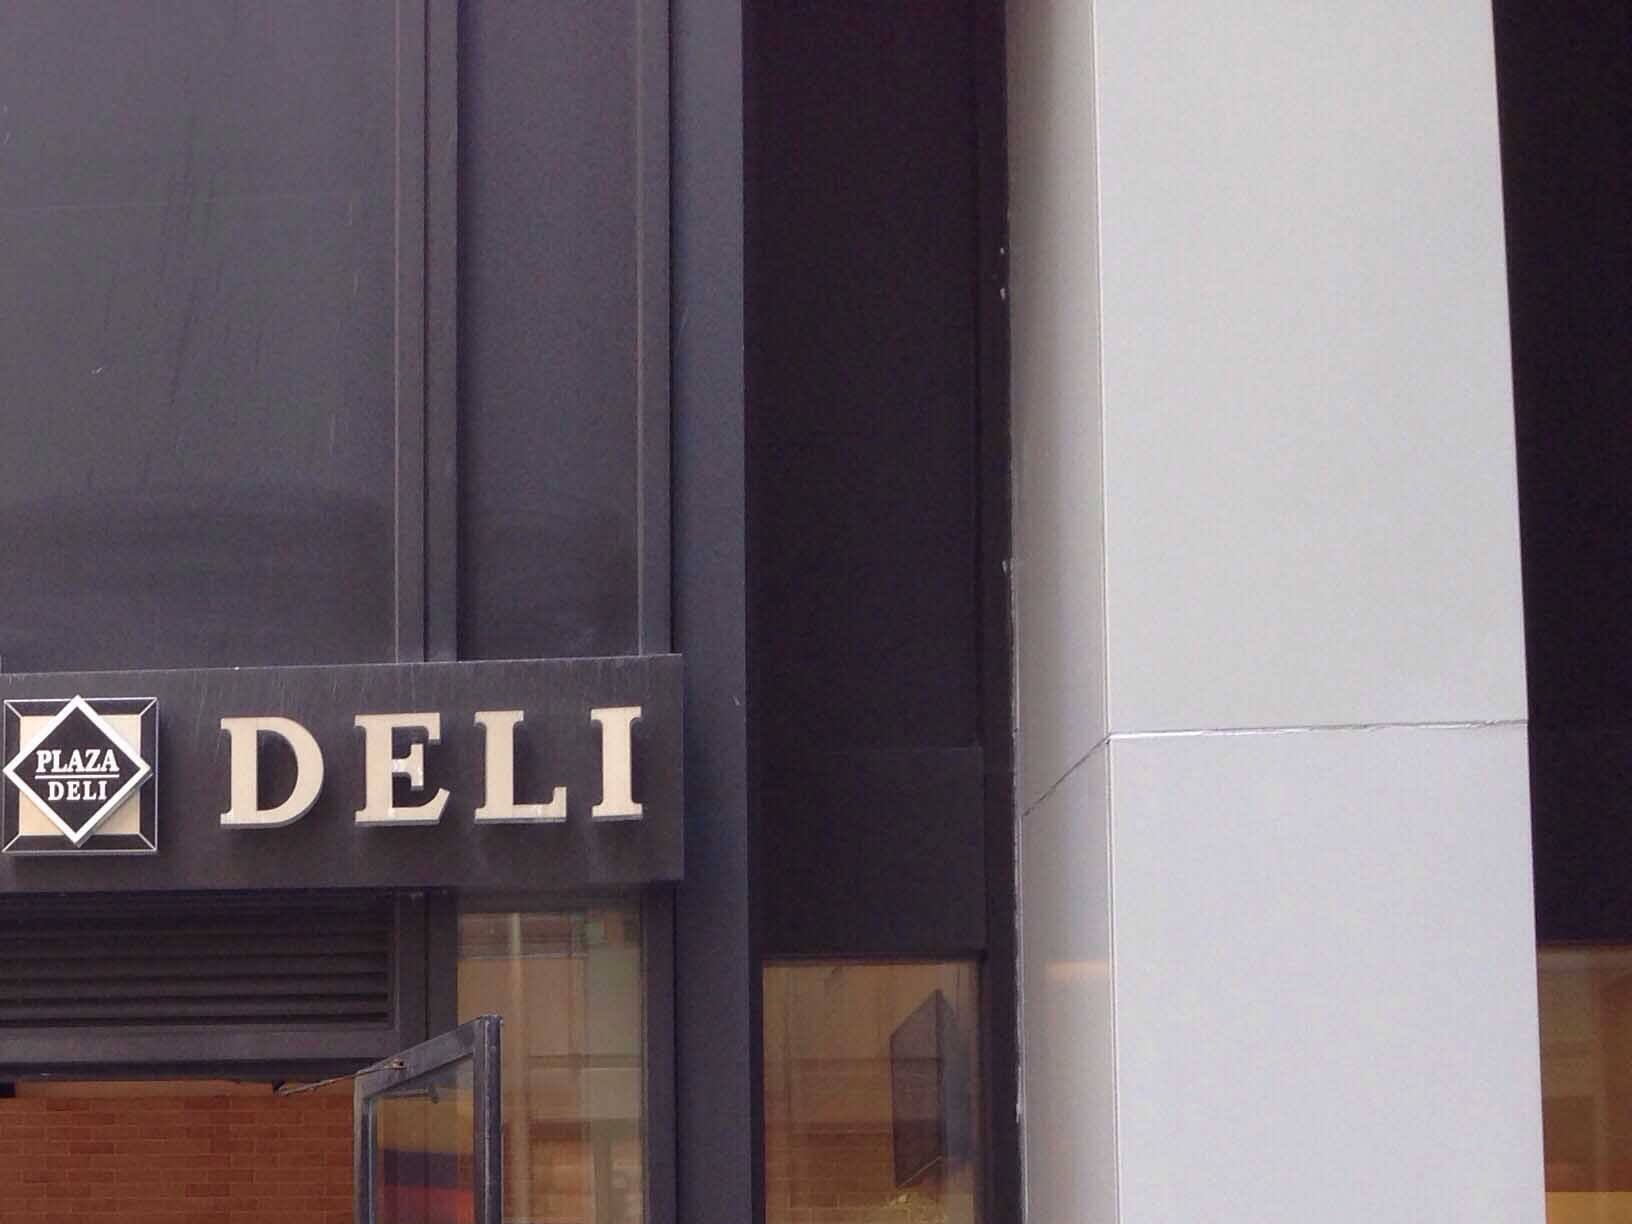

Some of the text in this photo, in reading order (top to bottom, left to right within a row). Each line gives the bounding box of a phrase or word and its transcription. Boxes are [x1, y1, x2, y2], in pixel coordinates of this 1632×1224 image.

[35, 749, 120, 773] PLAZA
[220, 705, 643, 829] DELI
[47, 780, 108, 801] DELI
